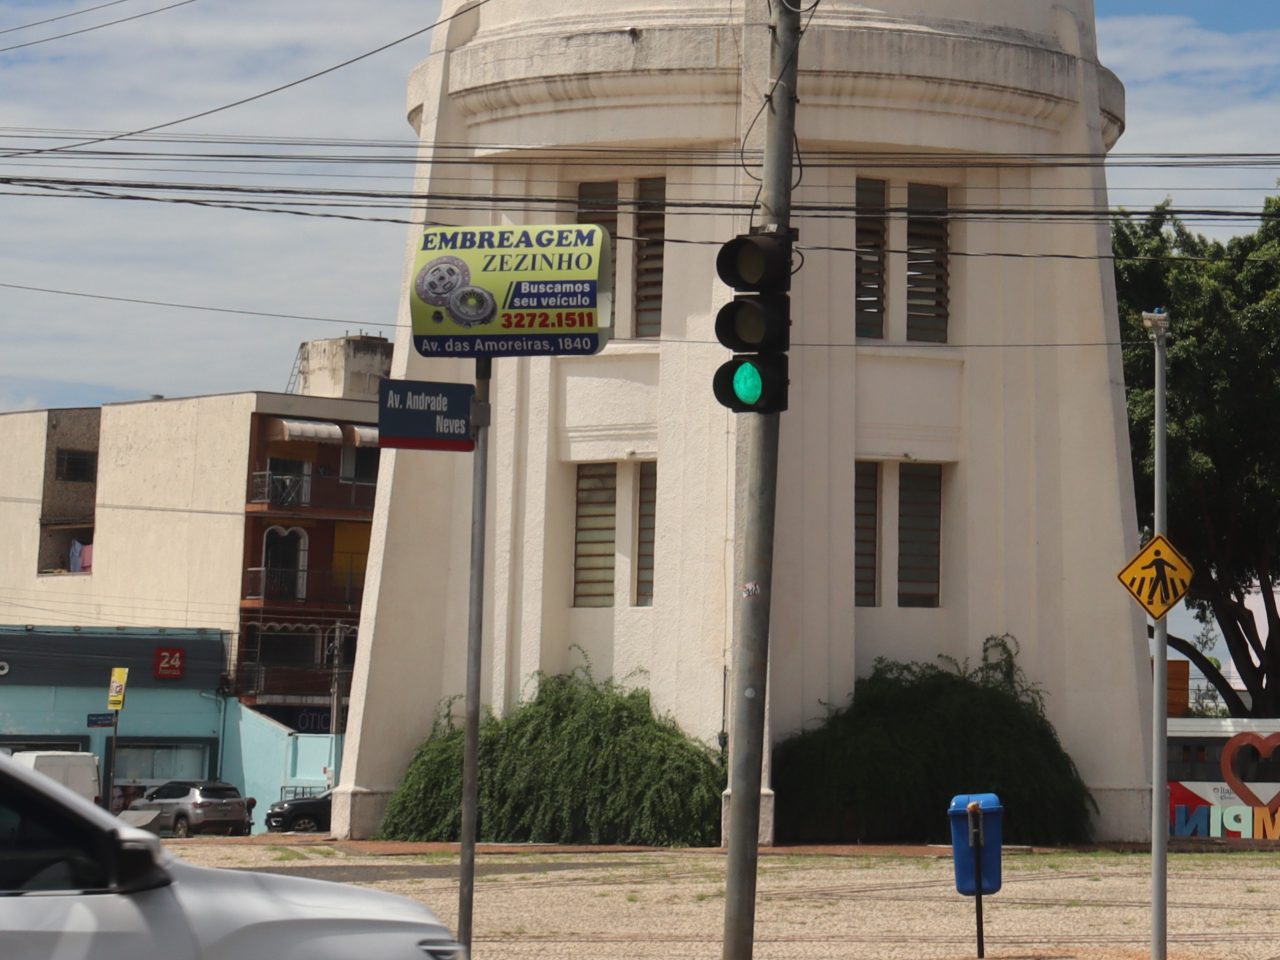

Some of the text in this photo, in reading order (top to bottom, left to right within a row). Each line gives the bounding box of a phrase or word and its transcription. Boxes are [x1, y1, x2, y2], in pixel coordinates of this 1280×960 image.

[421, 229, 596, 251] EMBREAGEM
[481, 252, 593, 273] ZEZINHO
[521, 282, 590, 294] Buscamos
[513, 295, 590, 307] seu veículo
[501, 312, 593, 329] 3272.1511
[421, 337, 591, 352] Av. das Amoreiras, 1840
[387, 390, 448, 411] Av. Andrade
[436, 415, 466, 434] Neves
[160, 652, 180, 667] 24
